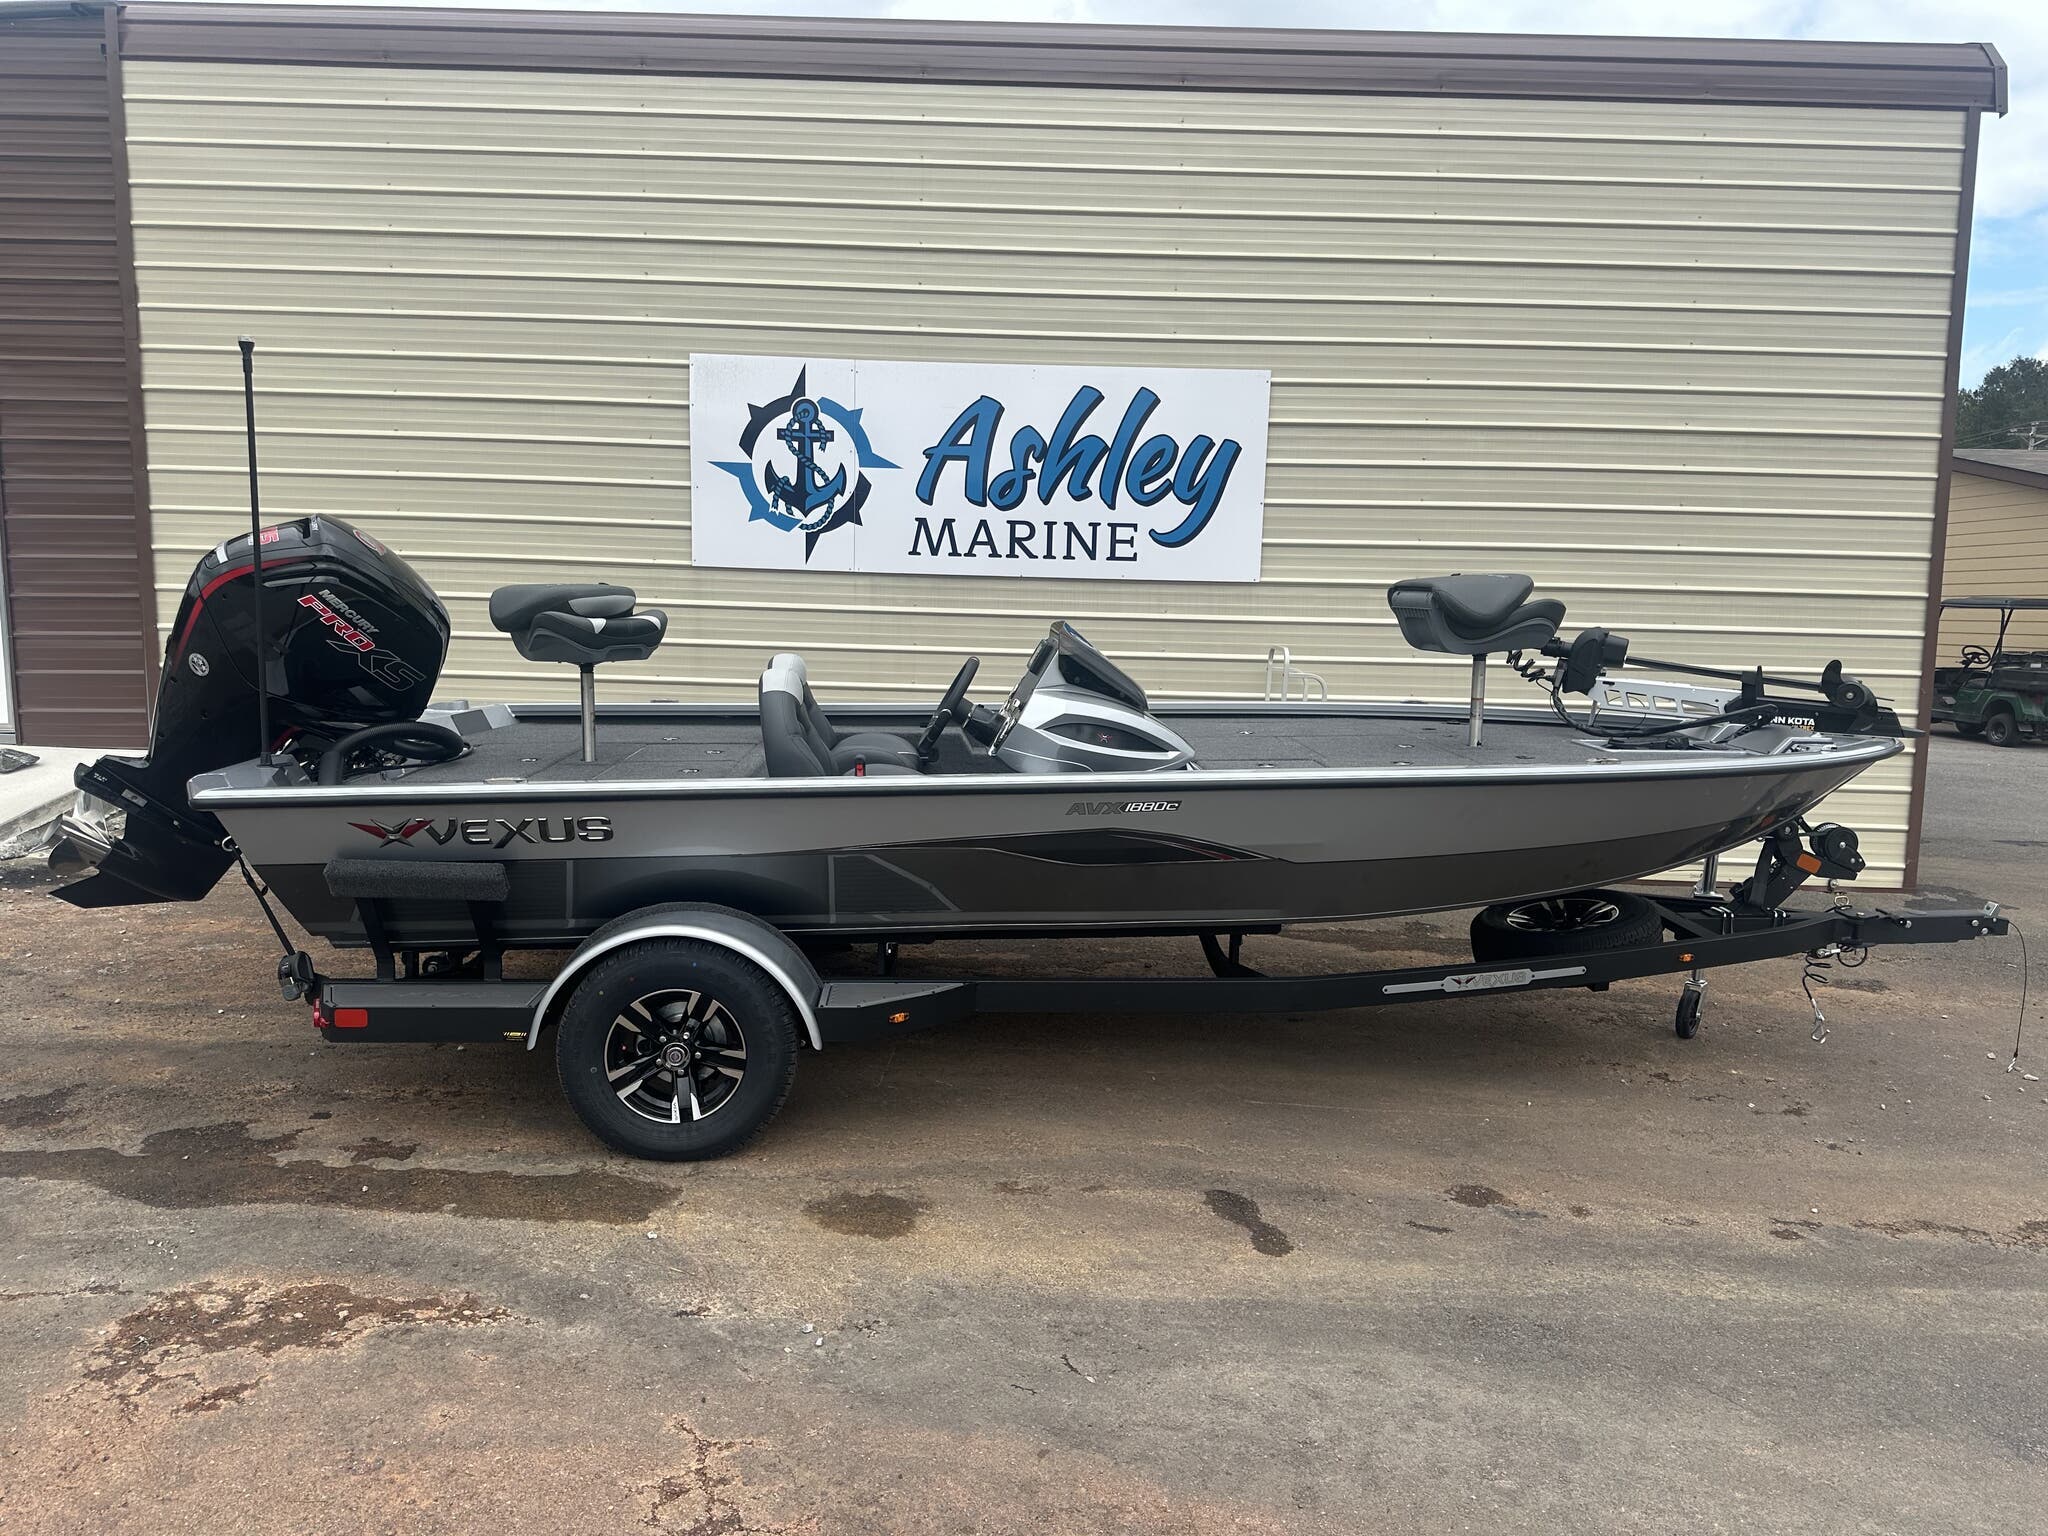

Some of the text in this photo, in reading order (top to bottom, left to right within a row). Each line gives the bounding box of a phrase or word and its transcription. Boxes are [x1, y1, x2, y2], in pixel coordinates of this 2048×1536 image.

[915, 385, 1242, 548] Ashley
[908, 517, 1138, 562] MARINE
[318, 589, 380, 634] MERCURY
[297, 594, 427, 692] PRO XS
[1787, 716, 1815, 726] KOTA
[414, 816, 615, 849] VEXUS
